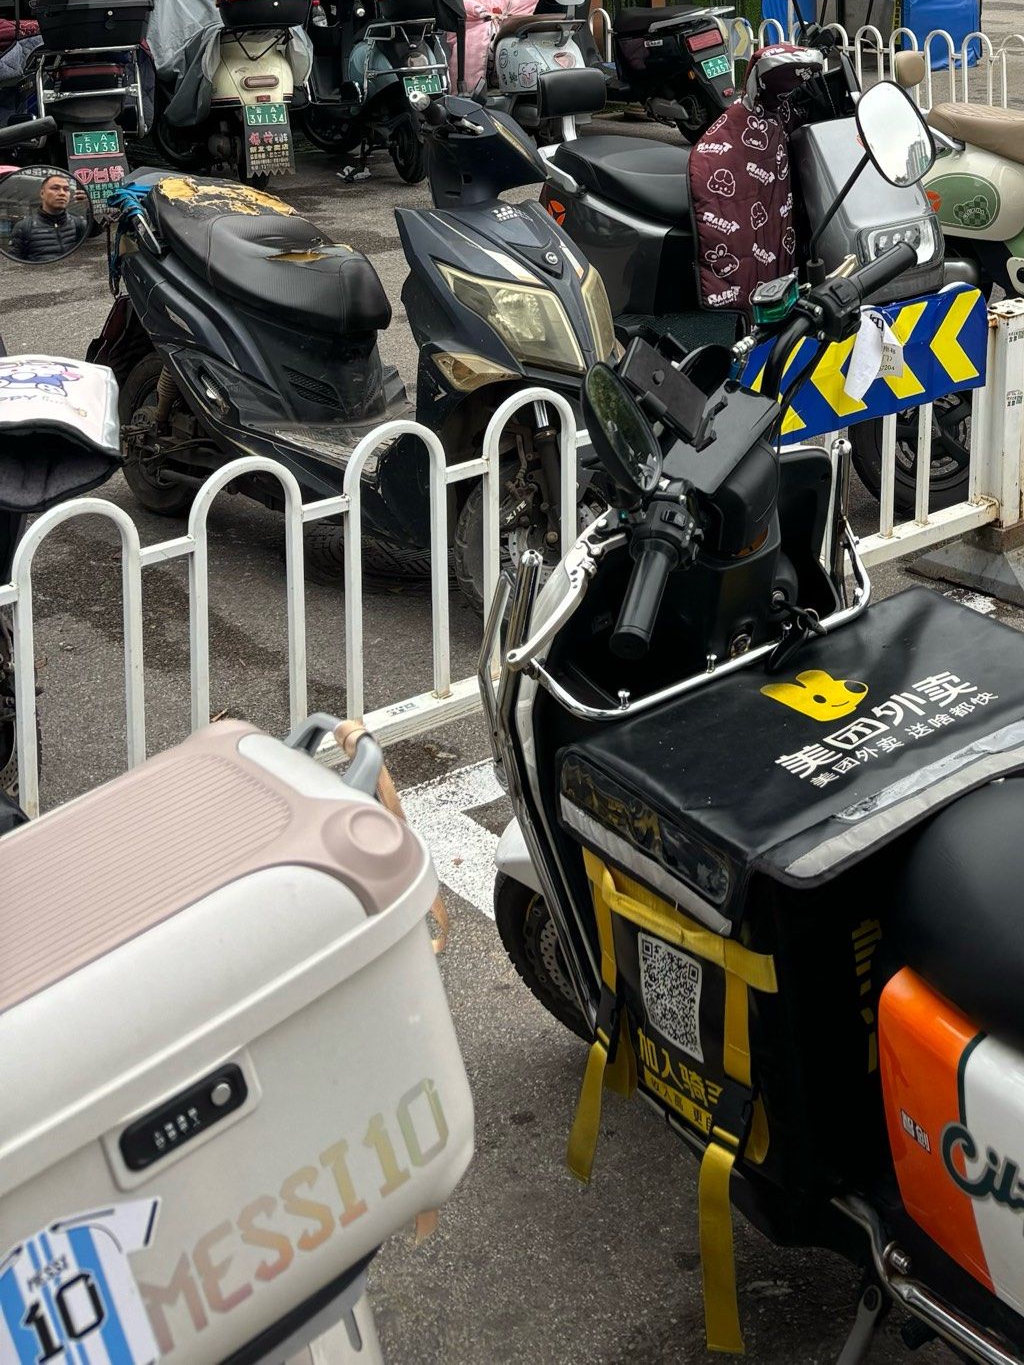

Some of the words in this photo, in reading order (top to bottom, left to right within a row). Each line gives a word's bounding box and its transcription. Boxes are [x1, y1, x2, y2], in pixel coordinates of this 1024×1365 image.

[77, 141, 117, 153] 75V33
[774, 671, 978, 779] 美团外卖
[810, 735, 905, 788] 美团外卖
[904, 691, 999, 740] 送啥都快
[24, 1271, 106, 1365] 10
